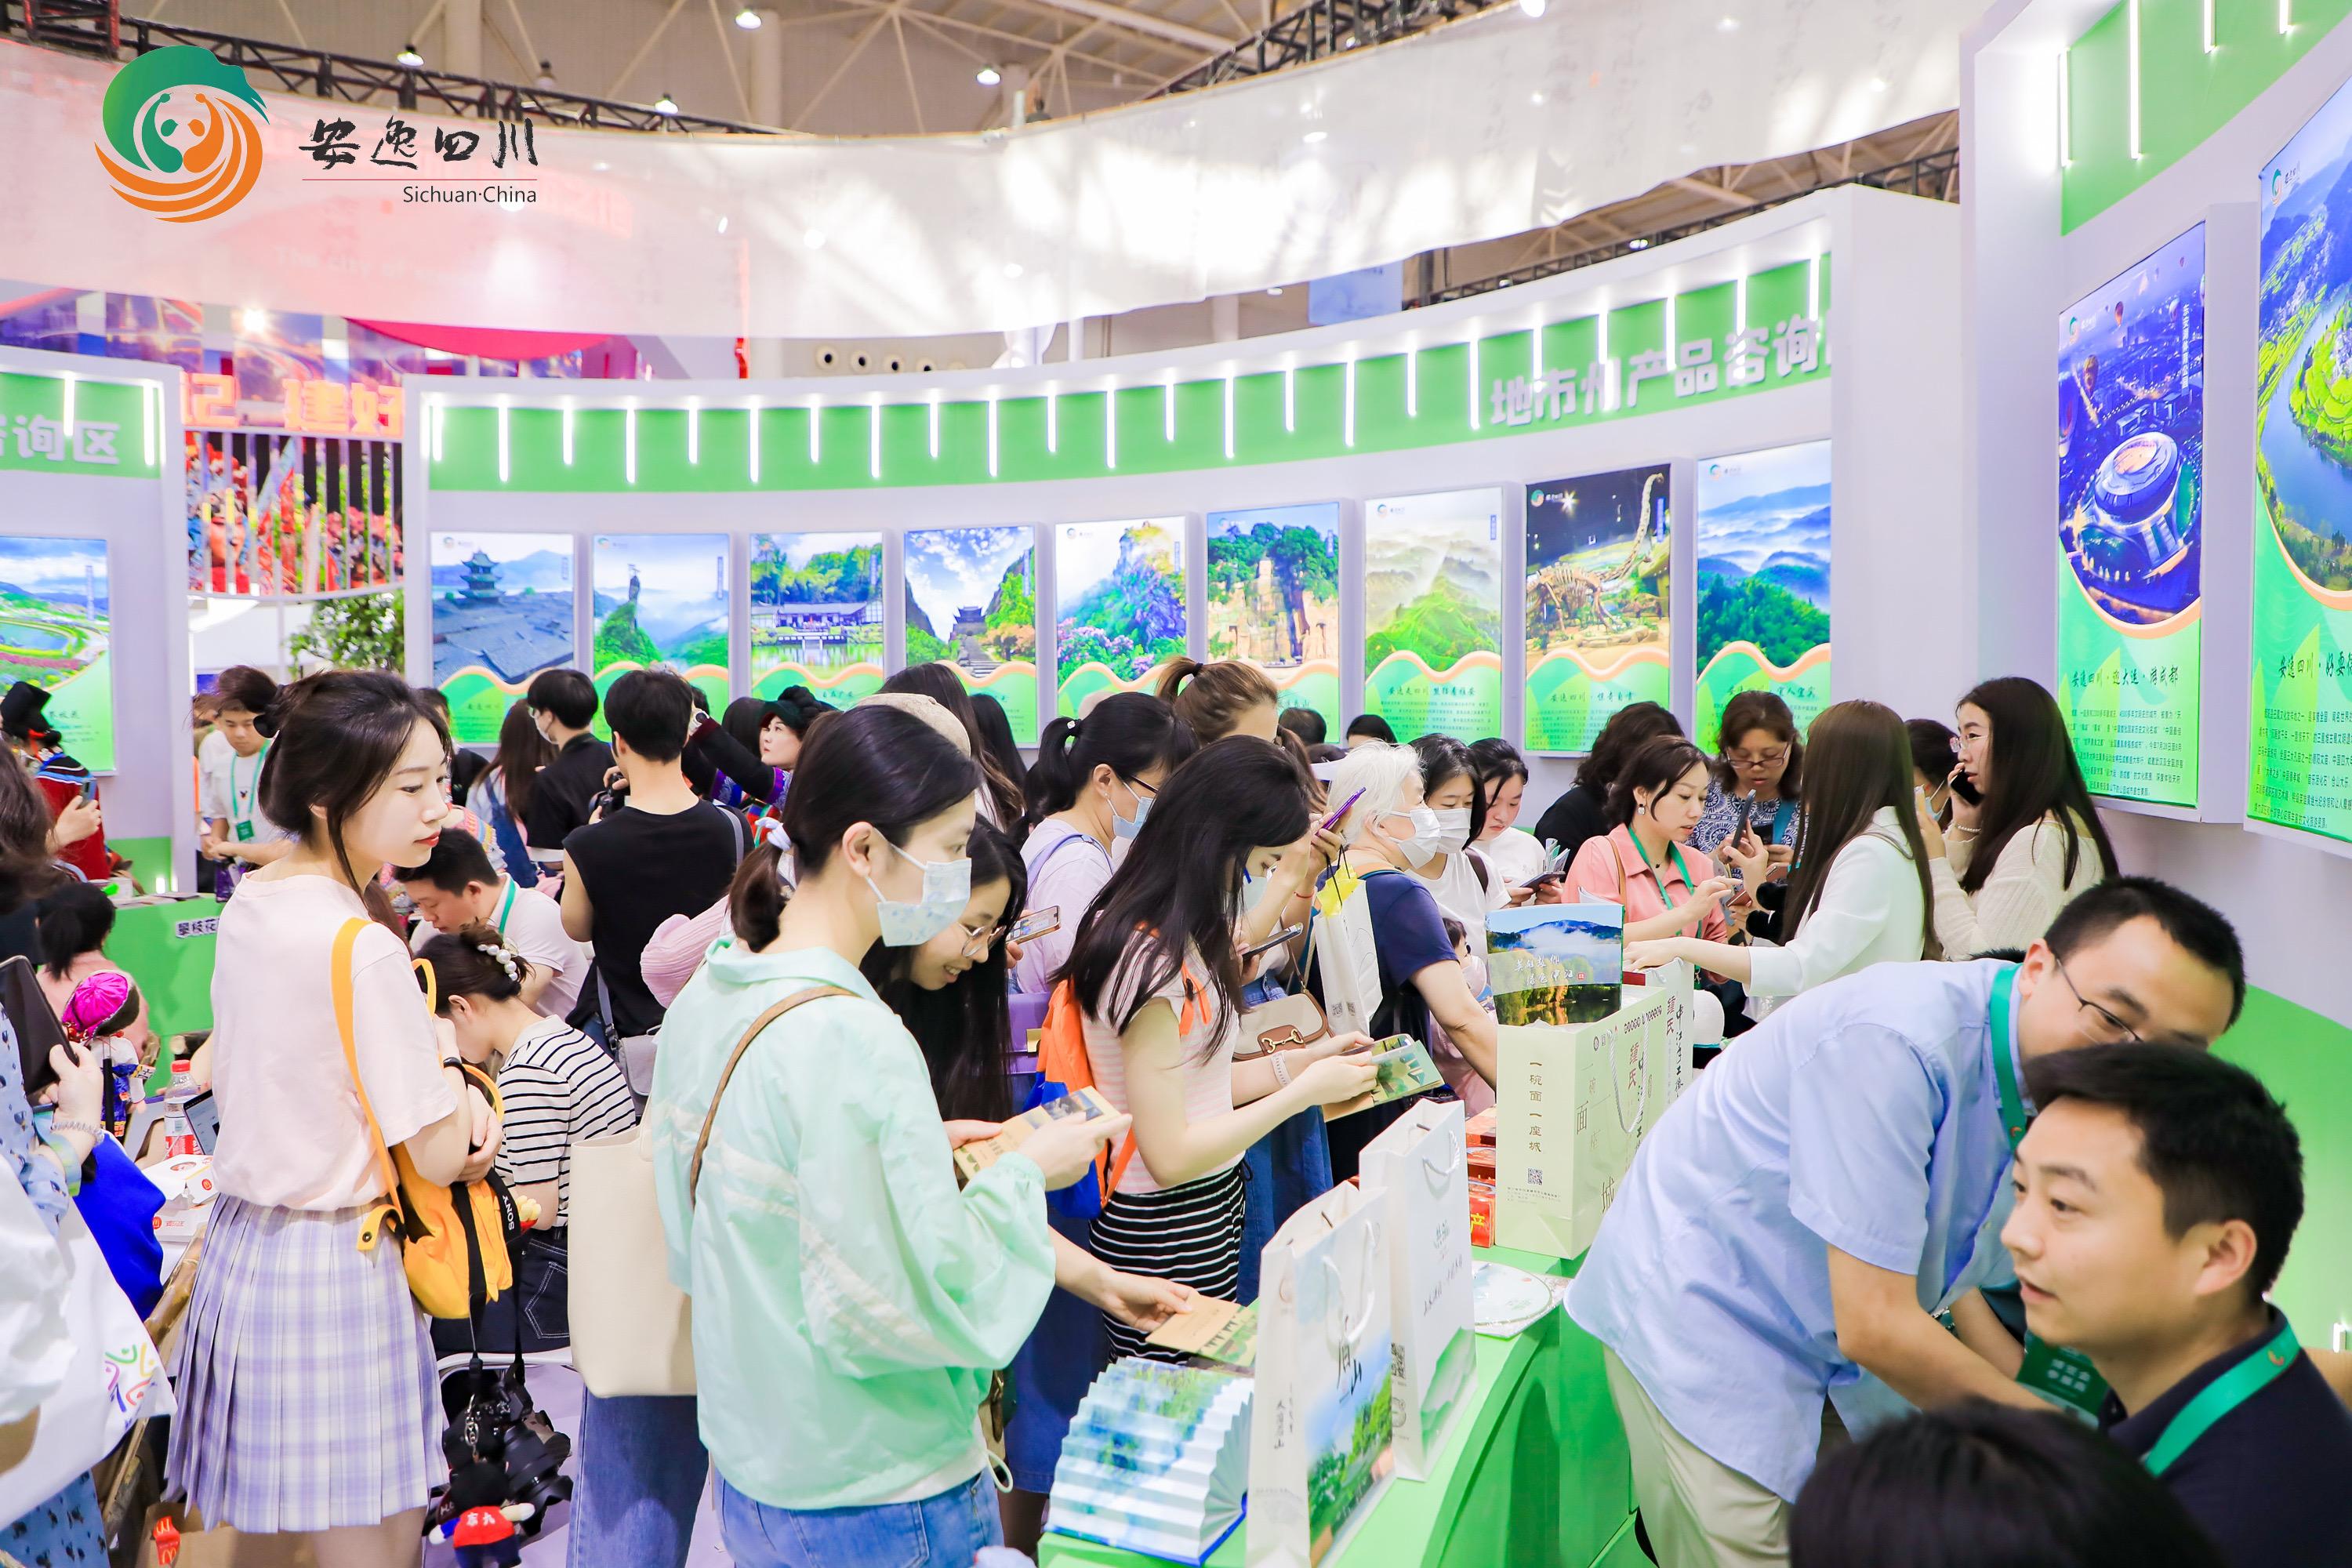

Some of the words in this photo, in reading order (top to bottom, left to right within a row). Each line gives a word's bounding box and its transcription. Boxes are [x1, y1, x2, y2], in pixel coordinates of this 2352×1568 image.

[1490, 309, 1831, 427] 地市州产品咨询
[0, 414, 120, 465] 询区
[178, 917, 220, 935] 攀枝花
[502, 1195, 515, 1230] SONY
